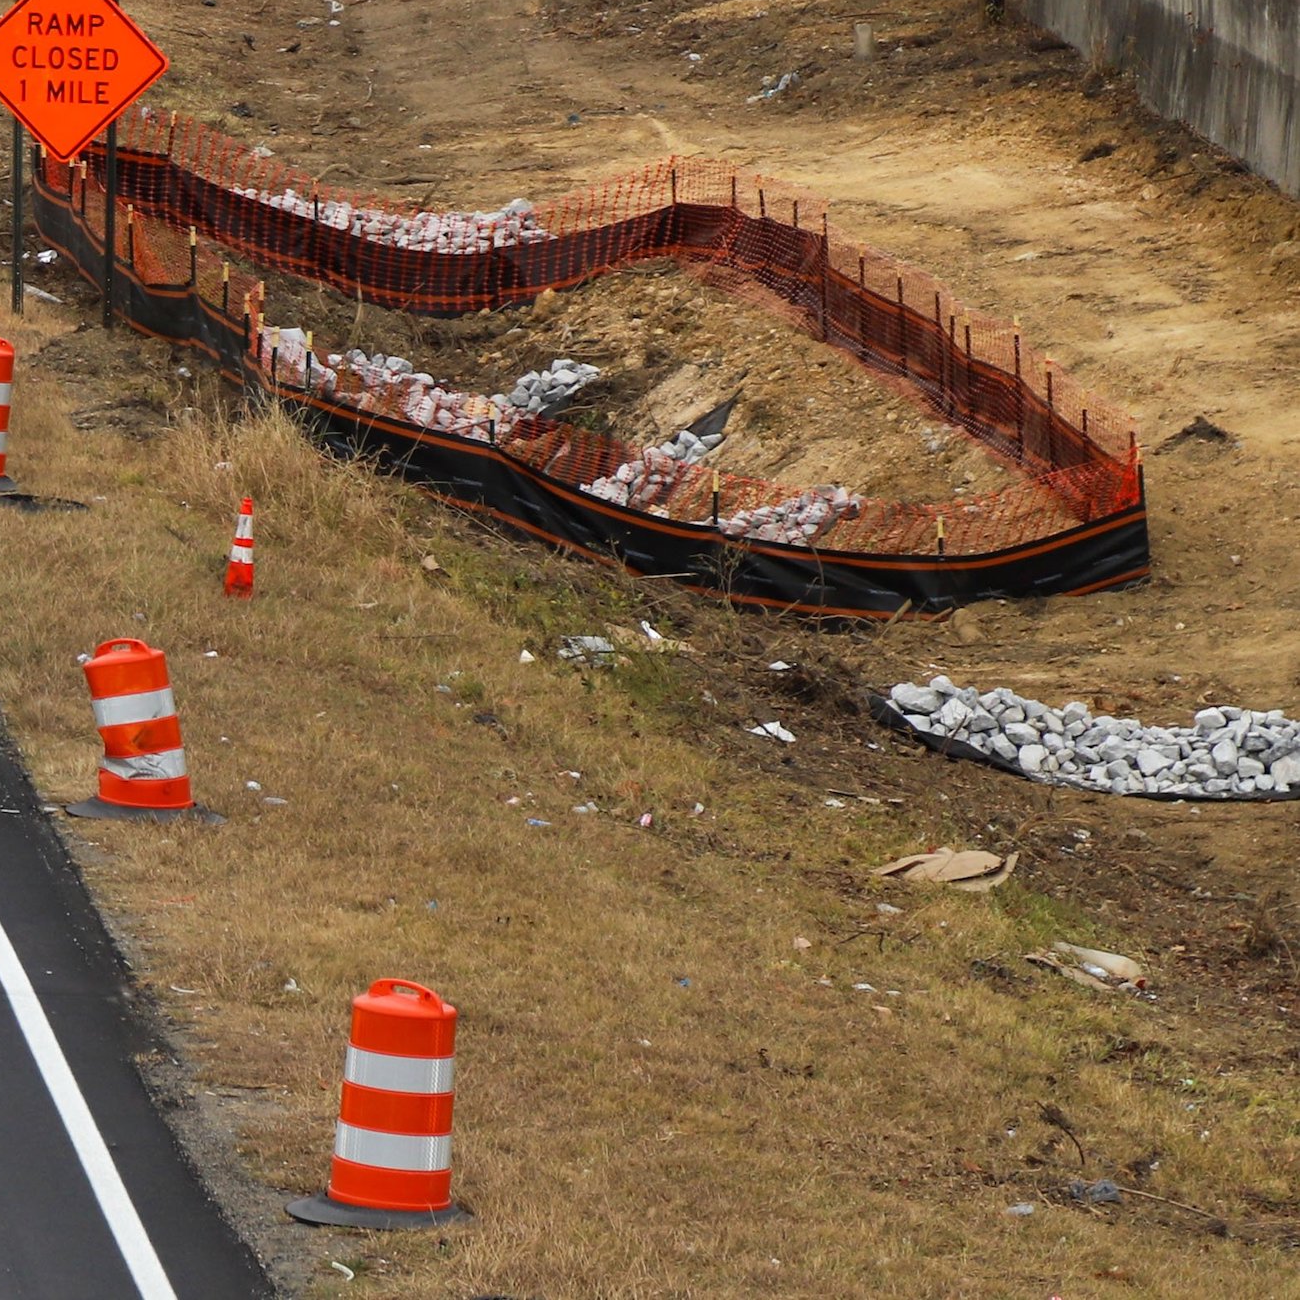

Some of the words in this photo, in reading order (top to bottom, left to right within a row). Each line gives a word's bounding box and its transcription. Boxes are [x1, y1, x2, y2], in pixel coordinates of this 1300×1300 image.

[27, 13, 105, 37] RAMP
[12, 46, 119, 71] CLOSED
[19, 79, 27, 102] 1
[47, 80, 109, 105] MILE
